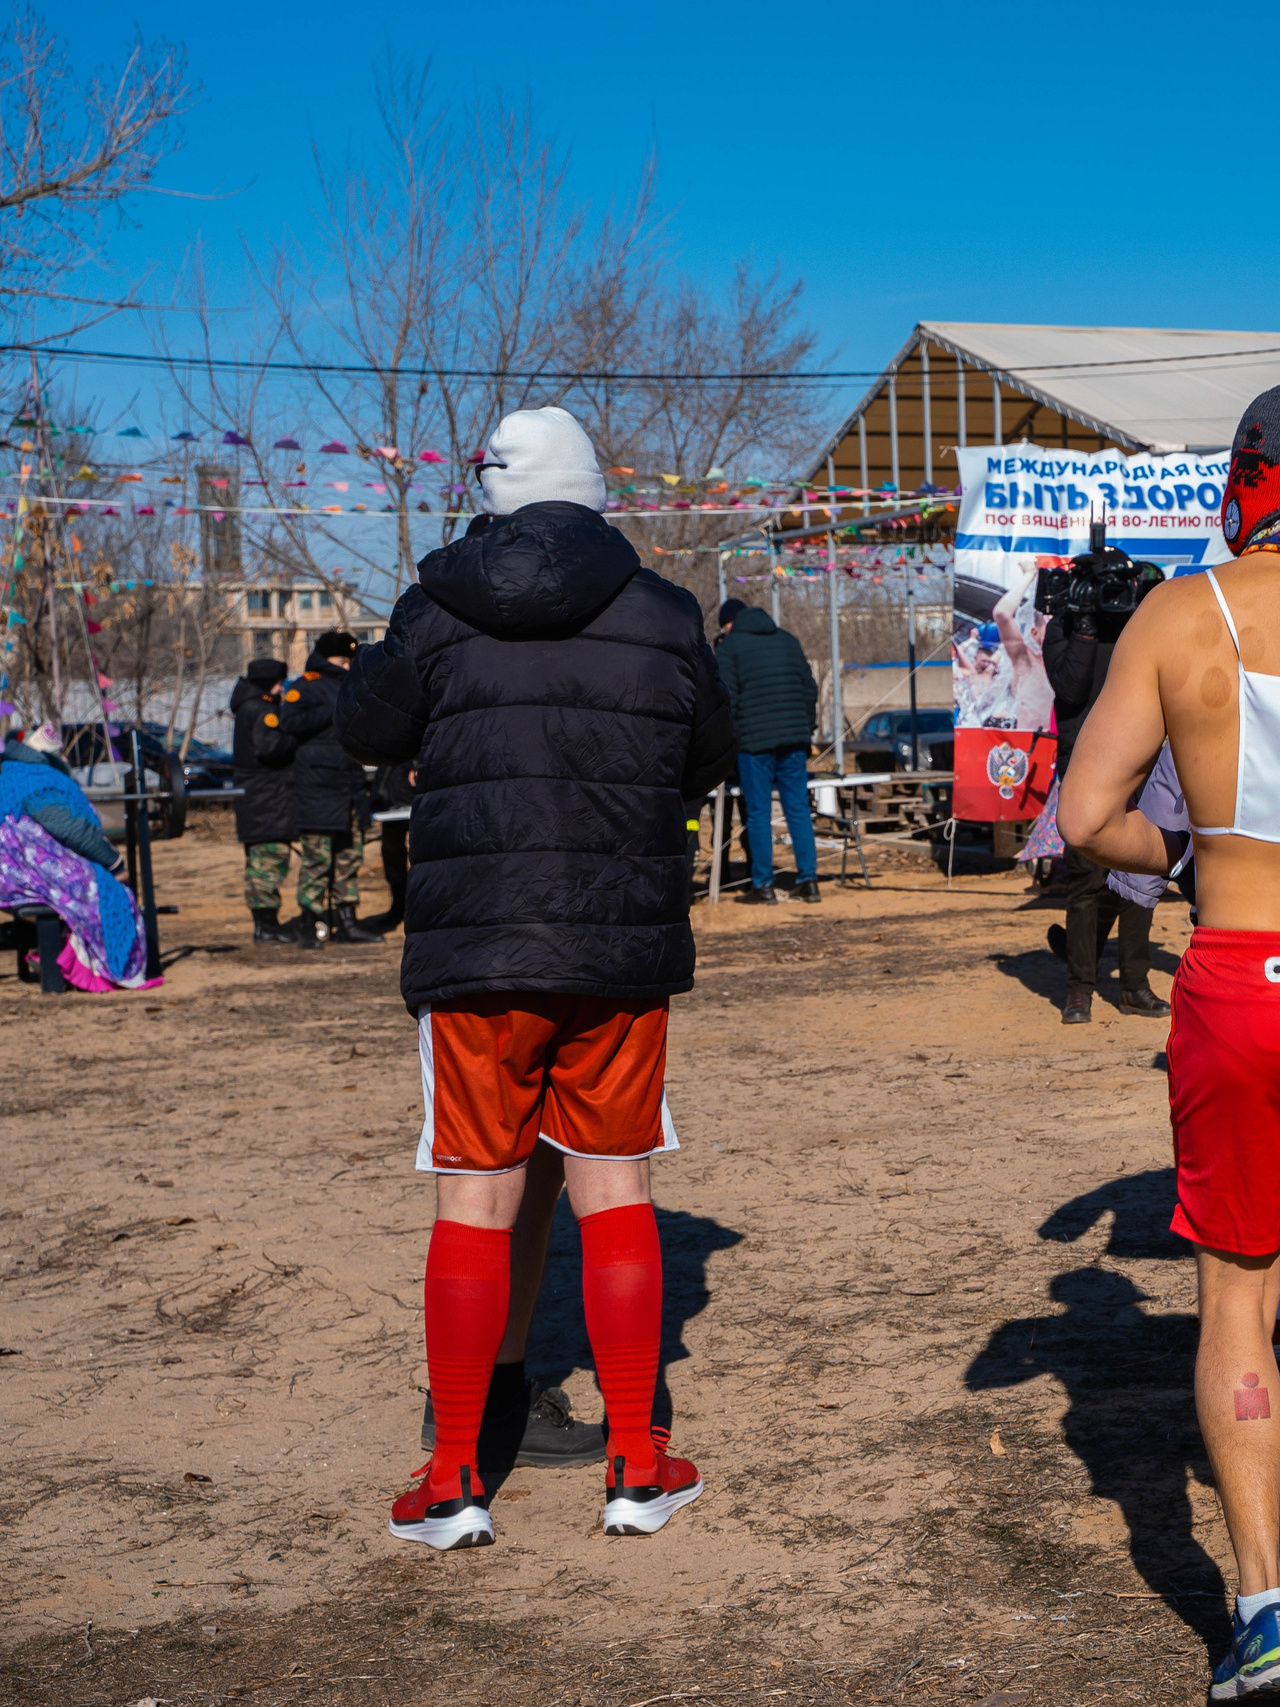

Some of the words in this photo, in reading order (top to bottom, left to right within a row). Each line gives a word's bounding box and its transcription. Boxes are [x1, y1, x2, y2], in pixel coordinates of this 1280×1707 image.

[987, 457, 1190, 481] МЕЖДУНАРОДНАЯ
[985, 482, 1089, 512] БЫТЬ
[1098, 482, 1228, 512] ЗДОРО
[1121, 515, 1201, 529] 80-ЛЕТИЮ
